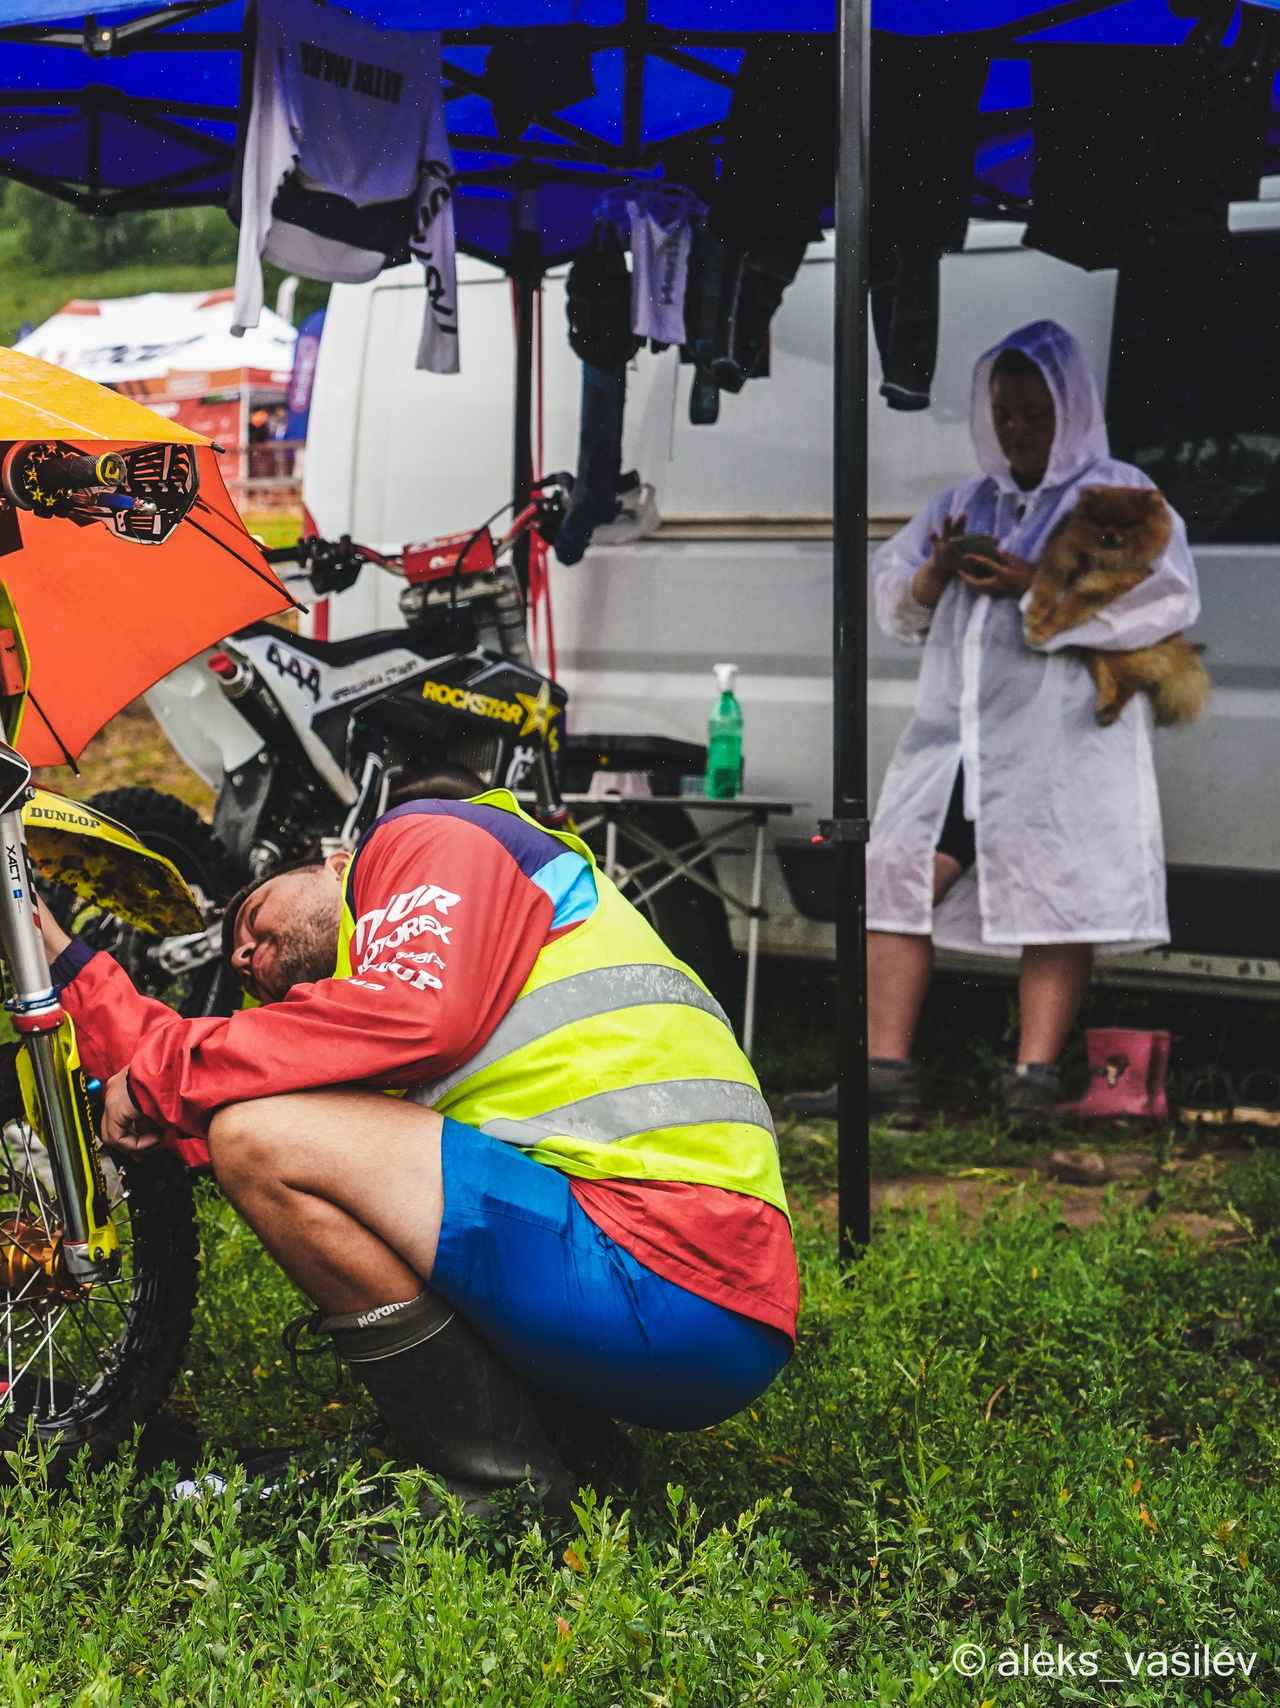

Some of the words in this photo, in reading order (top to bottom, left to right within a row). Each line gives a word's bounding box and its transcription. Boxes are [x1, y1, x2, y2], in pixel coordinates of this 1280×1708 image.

[266, 641, 322, 704] 444
[422, 680, 524, 725] ROCKSTAR
[30, 807, 101, 829] DUNLOP
[5, 844, 22, 883] XACT
[361, 914, 454, 968] OTOREX
